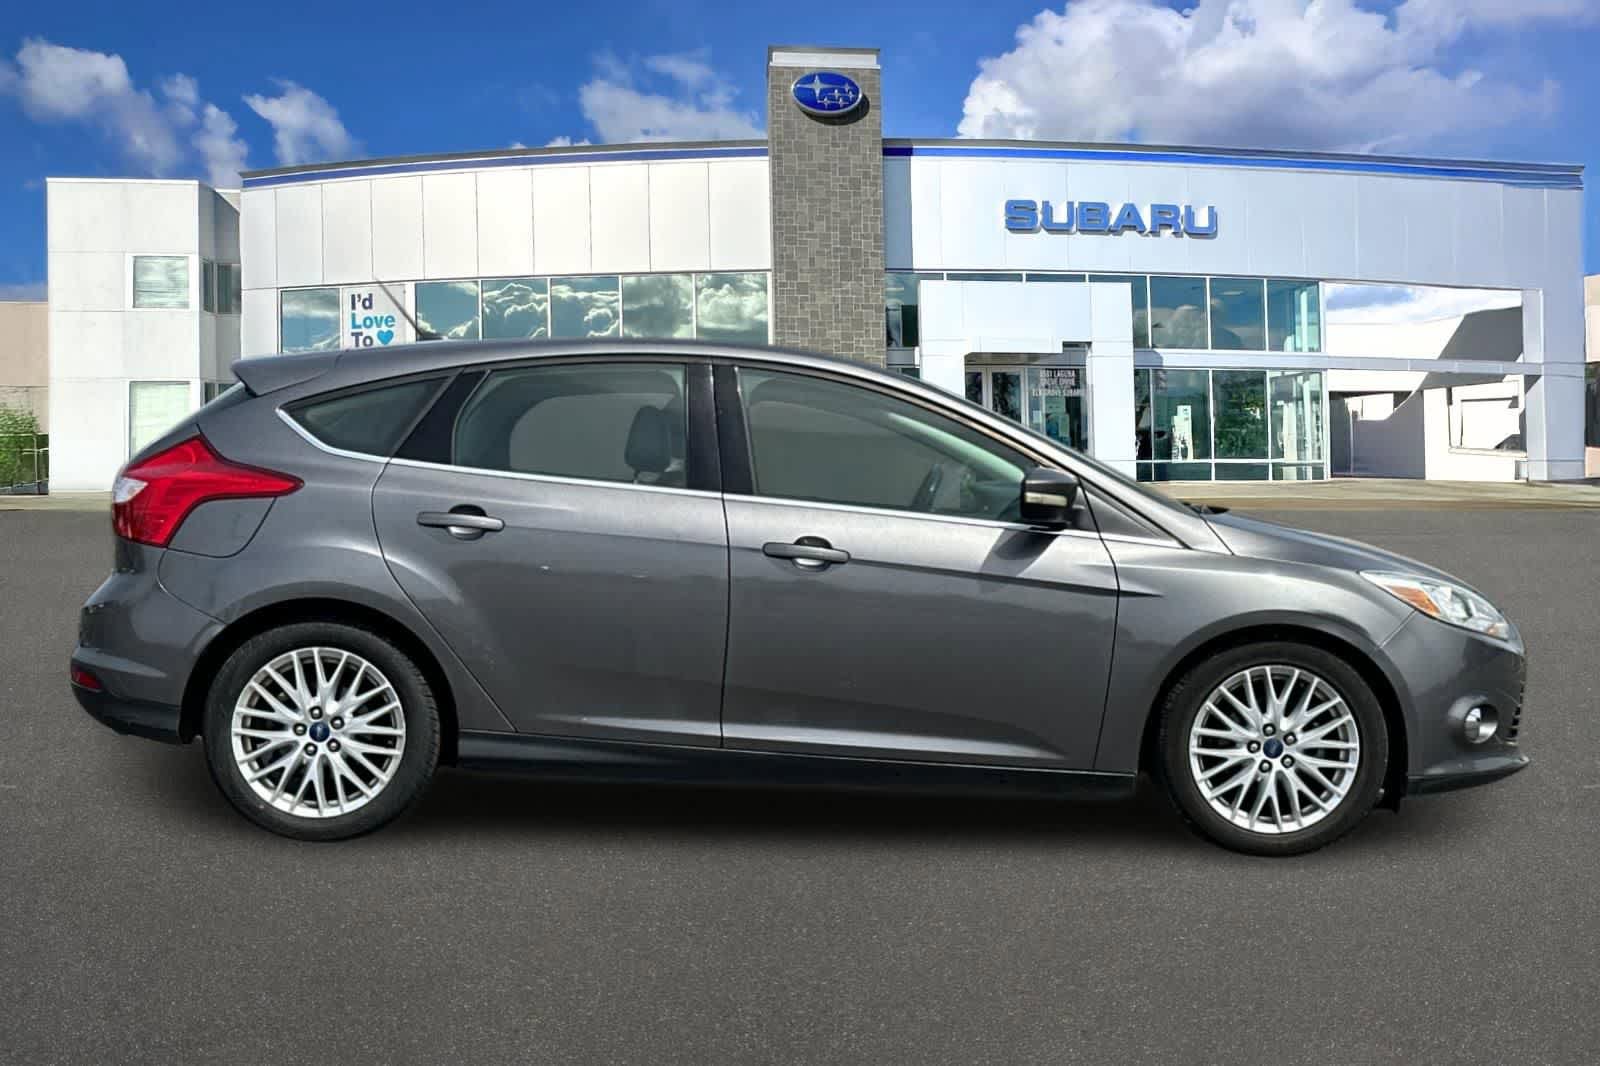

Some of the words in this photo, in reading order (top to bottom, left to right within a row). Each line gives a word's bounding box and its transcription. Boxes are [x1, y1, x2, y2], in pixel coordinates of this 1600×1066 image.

[1005, 199, 1217, 238] SUBARU
[351, 293, 373, 310] I'd
[351, 312, 395, 329] Love
[351, 331, 374, 347] To
